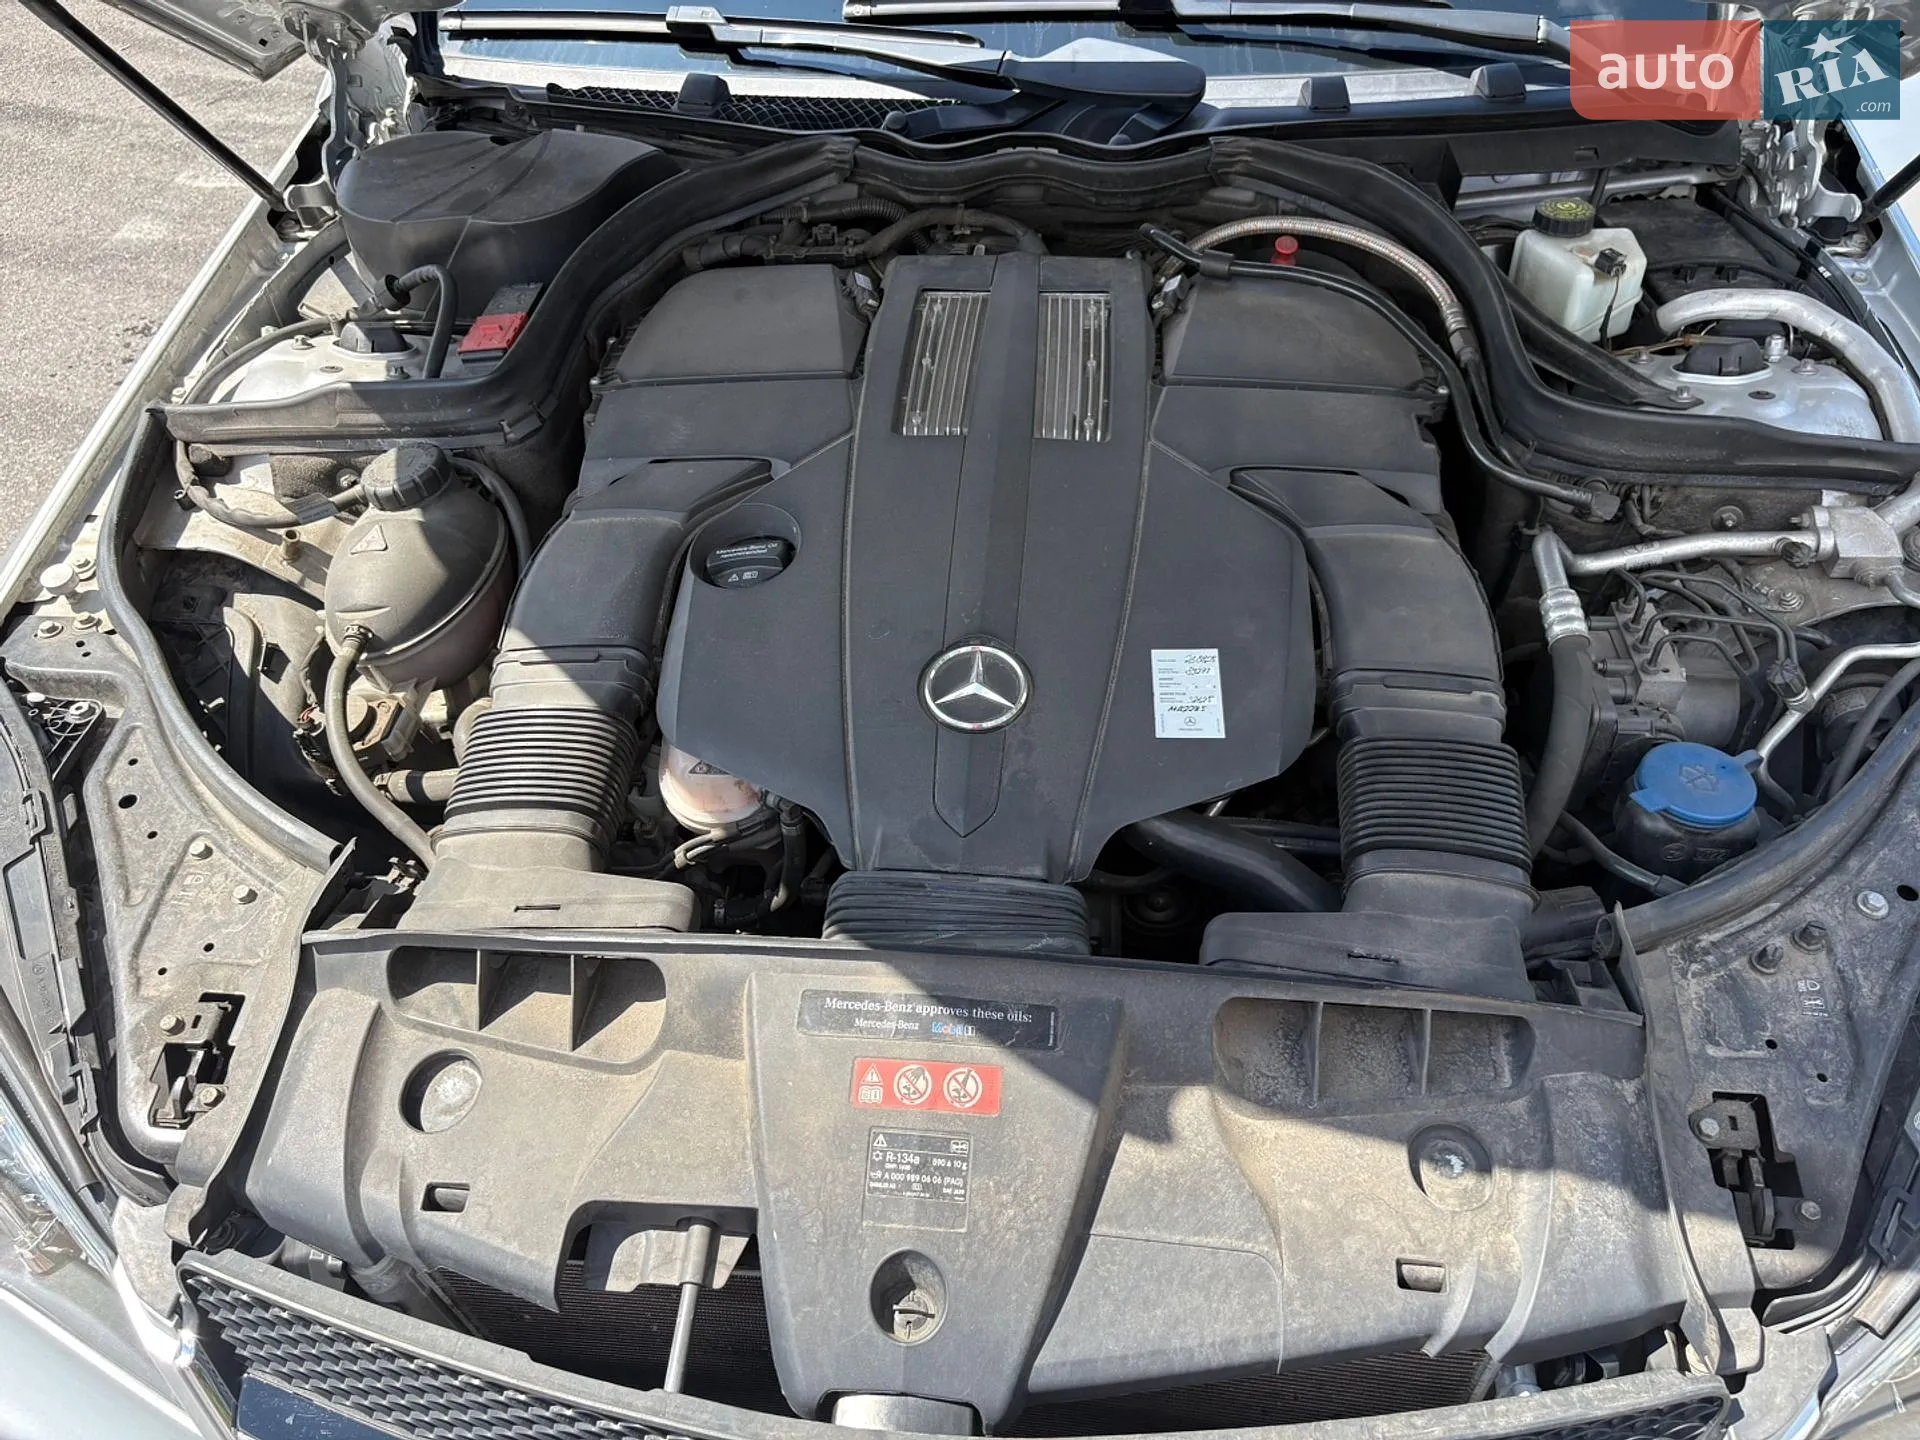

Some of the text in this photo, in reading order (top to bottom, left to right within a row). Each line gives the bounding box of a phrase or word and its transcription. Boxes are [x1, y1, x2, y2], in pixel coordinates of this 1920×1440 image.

[824, 997, 1033, 1023] Mercedes-Benz approves these oils:
[853, 1017, 920, 1031] Mercedes-Benz
[886, 1151, 920, 1164] R-134a
